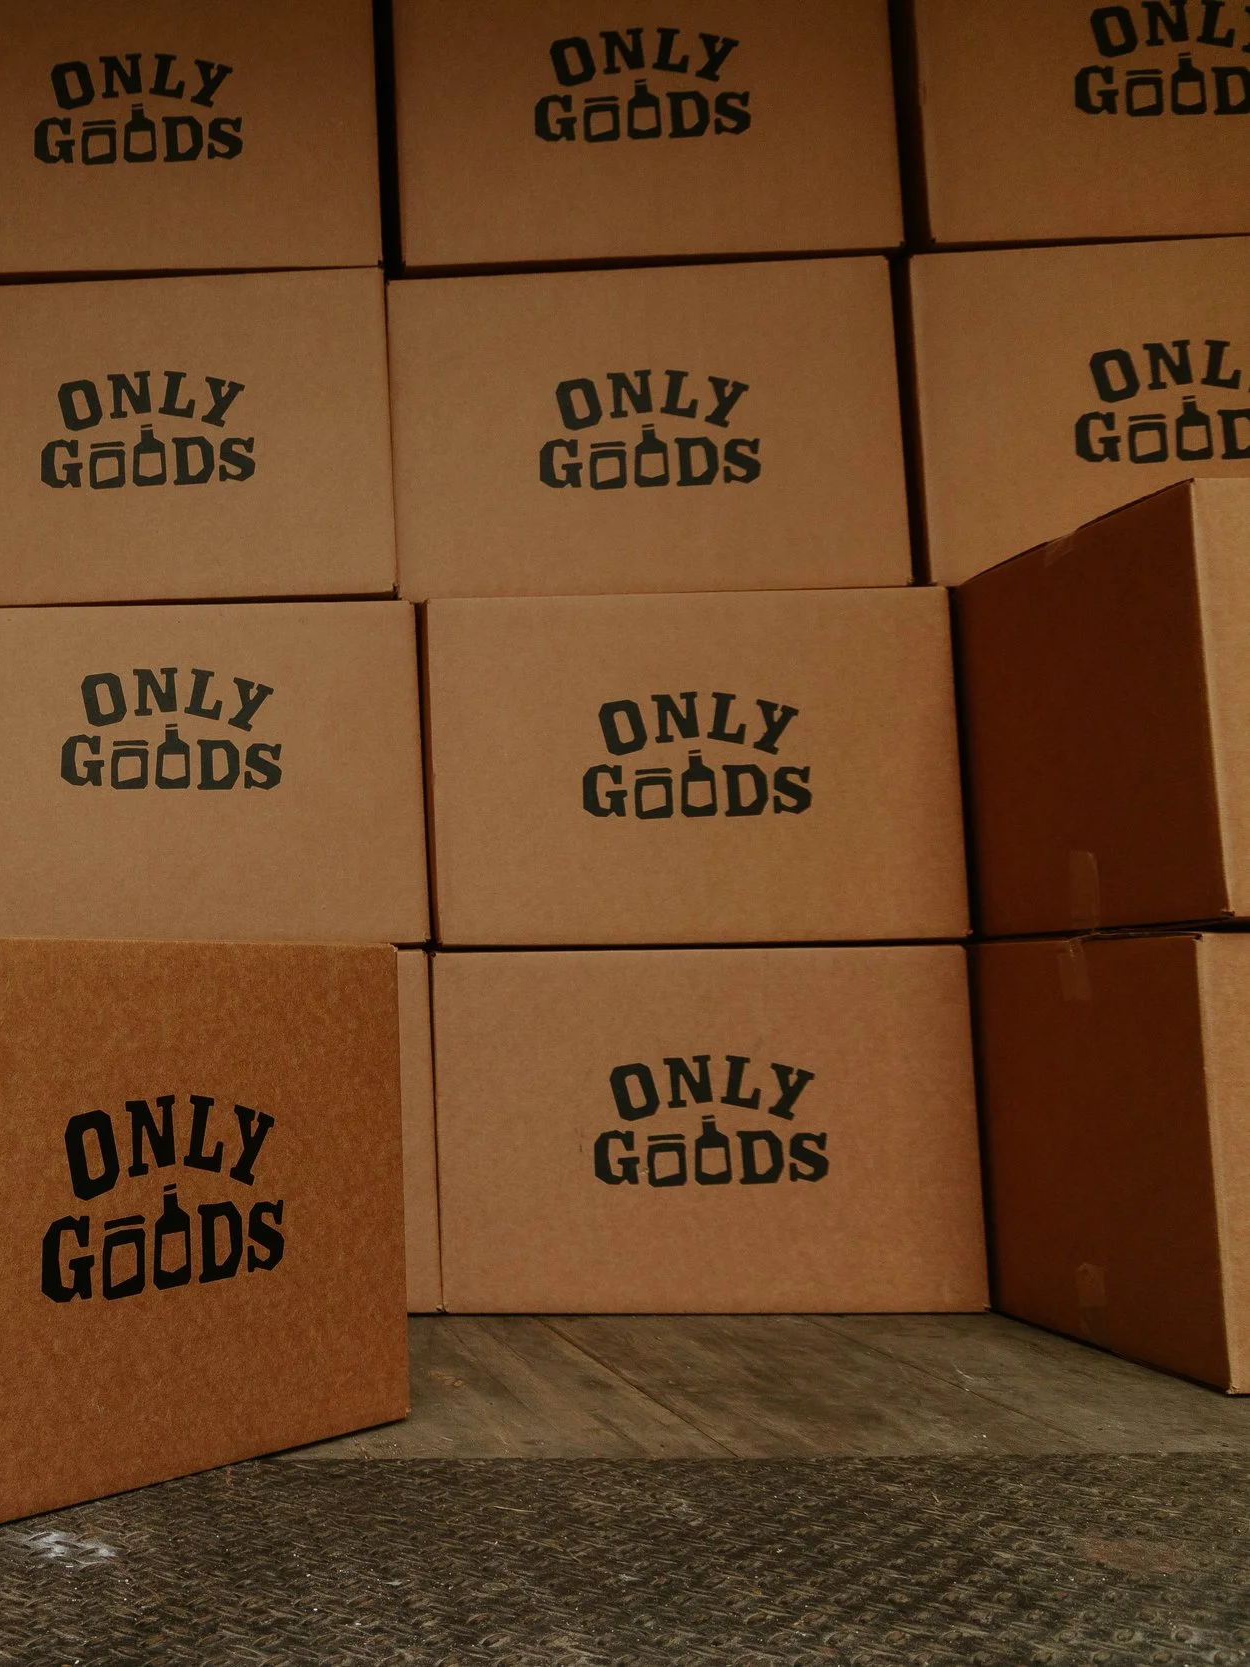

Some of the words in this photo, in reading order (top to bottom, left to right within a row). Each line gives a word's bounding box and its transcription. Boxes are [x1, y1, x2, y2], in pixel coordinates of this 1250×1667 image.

[549, 27, 740, 88] ONLY
[1089, 0, 1250, 58] ONL
[50, 52, 234, 111] ONLY
[534, 78, 752, 143] GOODS
[34, 102, 244, 166] GOODS
[57, 370, 246, 432] ONLY
[554, 368, 750, 432] ONLY
[1088, 339, 1250, 404] ONL
[40, 423, 256, 490] GOODS
[539, 423, 762, 491] GOODS
[80, 666, 275, 733] ONLY
[597, 691, 800, 757] ONLY
[60, 723, 283, 791] GOODS
[582, 749, 813, 820] GOODS
[609, 1054, 815, 1122] ONLY
[64, 1094, 275, 1202] ONLY
[593, 1114, 830, 1188] GOODS
[41, 1183, 285, 1304] GOODS
